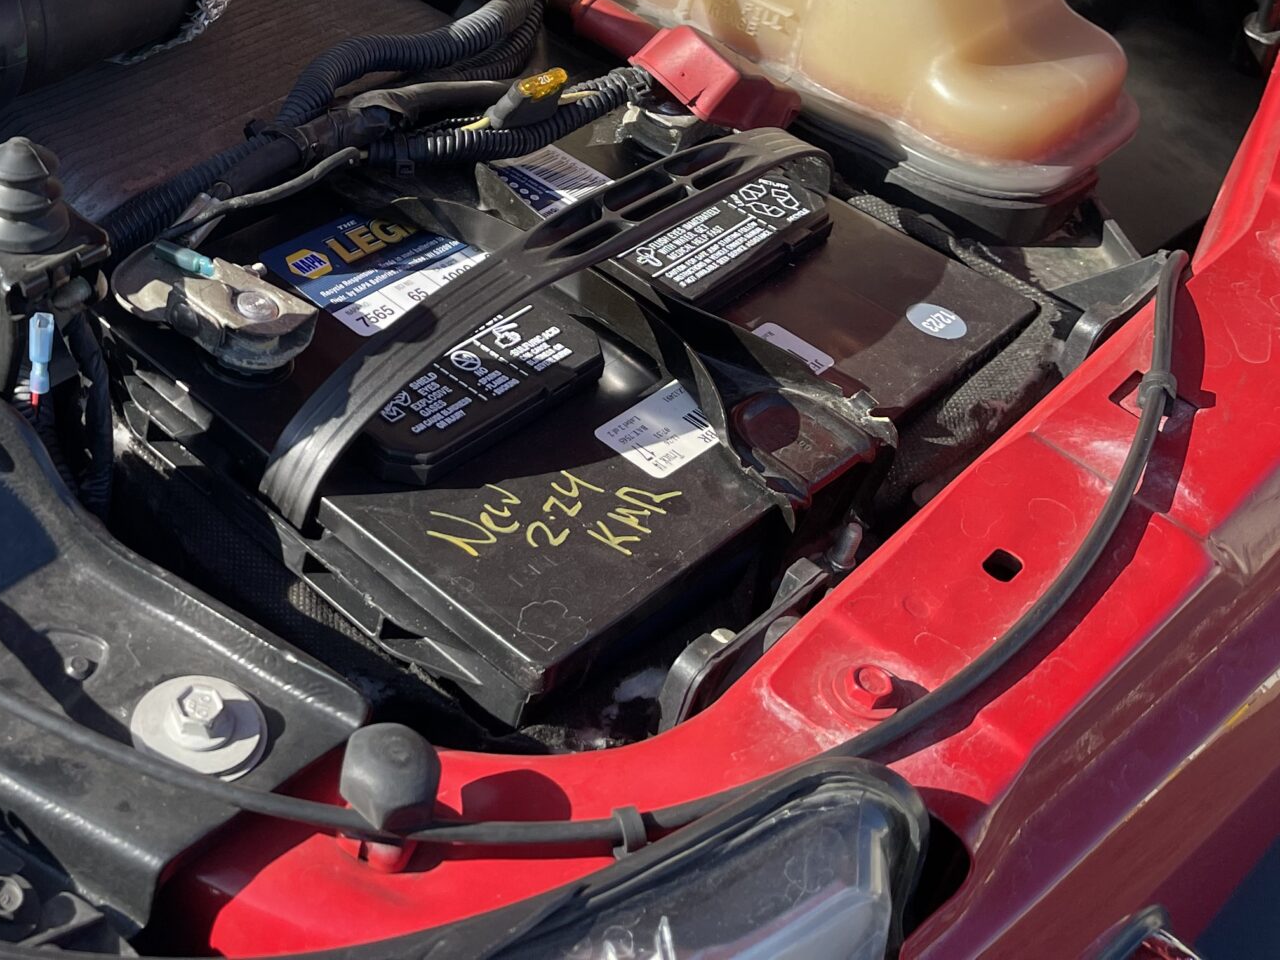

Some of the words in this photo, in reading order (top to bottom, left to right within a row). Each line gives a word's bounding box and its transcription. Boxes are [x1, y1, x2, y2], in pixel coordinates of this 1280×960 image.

[537, 74, 551, 85] 20
[336, 219, 358, 231] THE
[648, 234, 672, 250] FLUSH
[666, 226, 686, 239] EYES
[681, 205, 722, 231] IMMEDIATELY
[657, 242, 677, 255] WITH
[693, 223, 709, 233] GET
[666, 242, 696, 261] MEDICAL
[690, 232, 711, 246] HELP
[705, 224, 725, 237] FAST
[290, 252, 327, 274] NAPA
[351, 280, 373, 293] NAPA
[405, 286, 431, 302] 65
[354, 304, 397, 328] 7565
[922, 310, 956, 332] 12/23
[409, 372, 438, 390] SHIELD
[473, 366, 489, 377] NO
[410, 385, 453, 412] EXPLOSIVE
[417, 381, 440, 397] EYES
[420, 400, 447, 417] GASES
[629, 440, 657, 461] 17
[426, 484, 521, 556] New
